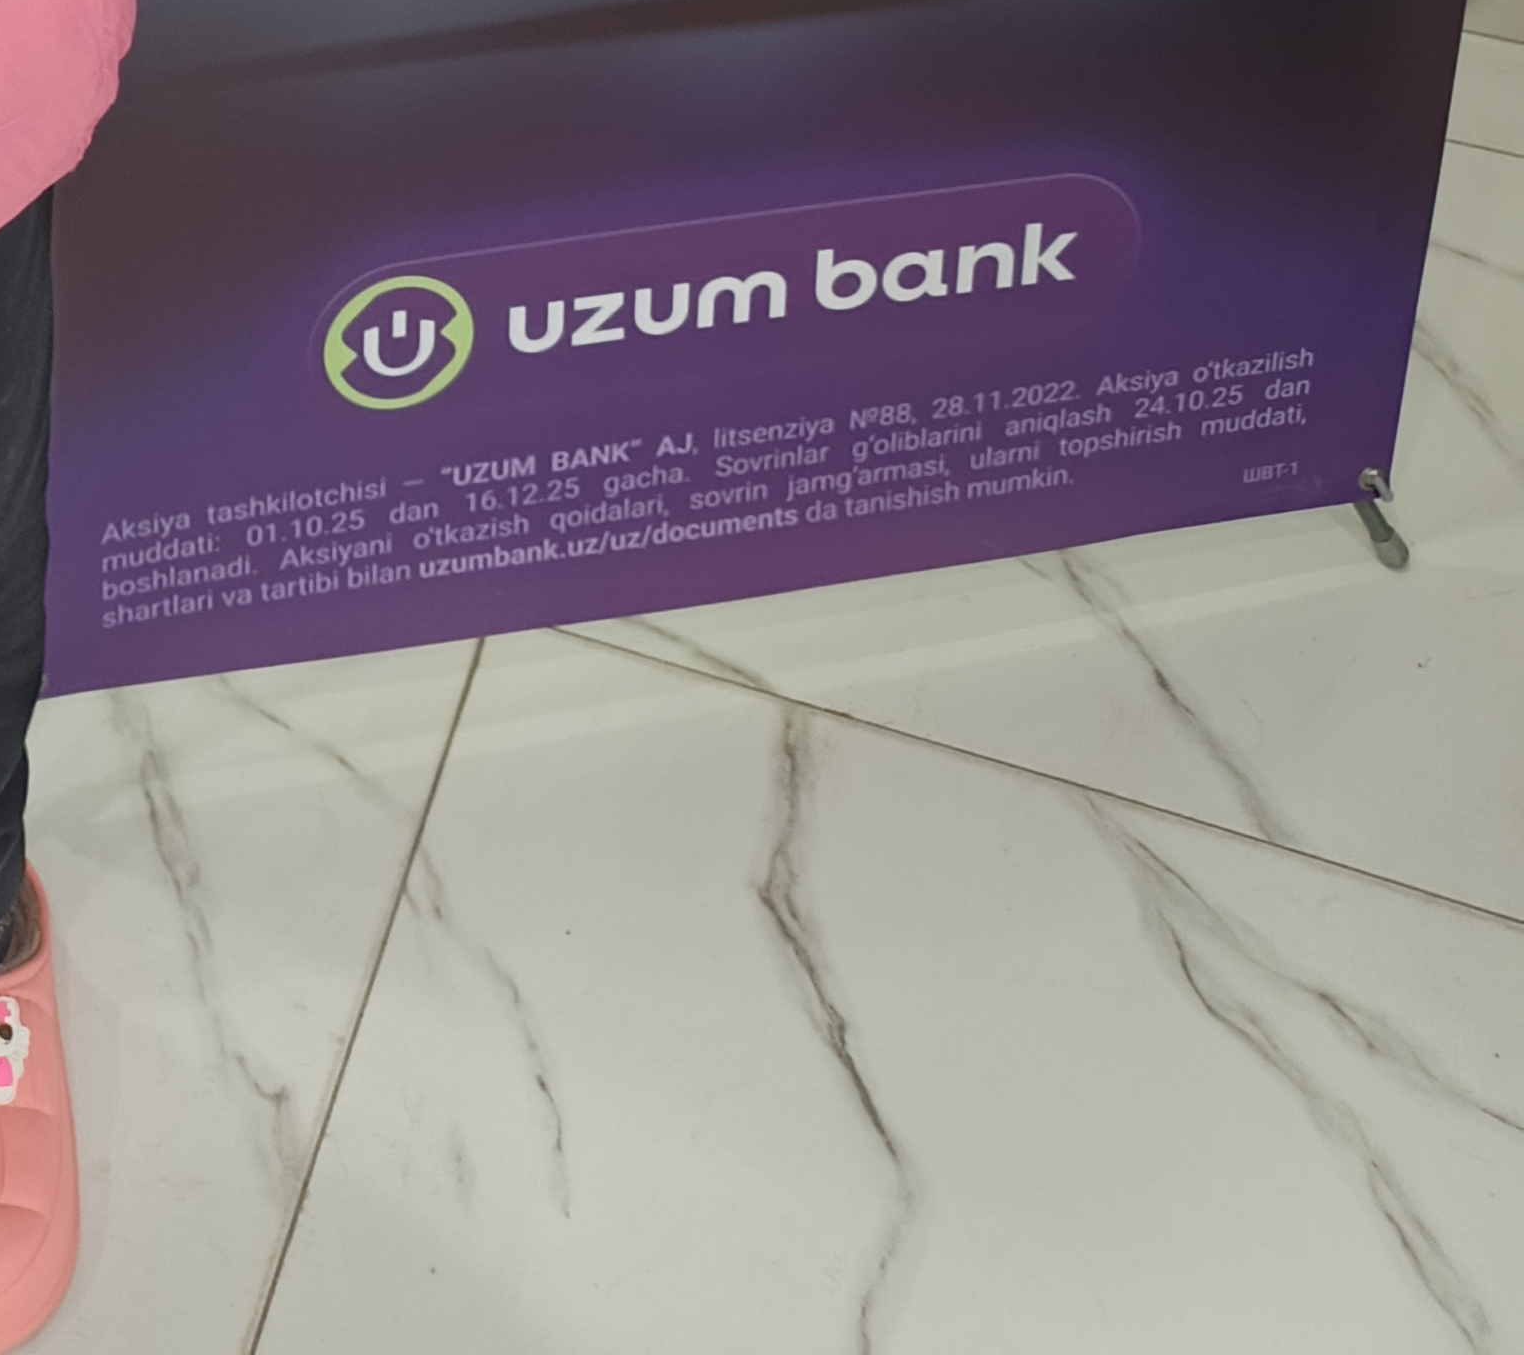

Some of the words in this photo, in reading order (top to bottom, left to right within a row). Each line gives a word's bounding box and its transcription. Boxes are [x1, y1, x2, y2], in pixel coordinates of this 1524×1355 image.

[508, 269, 786, 354] uzum
[814, 223, 1078, 310] bank
[101, 512, 191, 545] Aksiya
[207, 476, 387, 526] tashkilotchisi
[656, 433, 699, 458] AJ,
[714, 415, 835, 448] litsenziya
[1096, 369, 1179, 397] Aksiya
[101, 532, 221, 573] muddati:
[246, 508, 366, 548] 01.10.25
[389, 499, 440, 526] dan
[465, 477, 580, 513] 16.12.25
[603, 464, 691, 498] gacha.
[715, 444, 830, 478] Sovrinlar
[1005, 402, 1112, 438] aniqlash
[1134, 384, 1244, 419] 24.10.25
[1264, 378, 1311, 401] dan
[102, 555, 258, 601] boshlanadi.
[278, 532, 393, 572] Aksiyani
[549, 493, 670, 534] qoidalari,
[689, 481, 769, 511] sovrin
[969, 441, 1041, 471] ularni
[1060, 421, 1182, 458] topshirish
[1200, 403, 1308, 437] muddati,
[101, 590, 214, 629] shartlari
[221, 587, 253, 609] va
[260, 567, 339, 603] tartibi
[347, 562, 411, 590] bilan
[419, 507, 800, 579] uzumbank.uz/uz/documents
[805, 499, 839, 524] da
[845, 479, 961, 518] tanishish
[967, 465, 1074, 499] mumkin.
